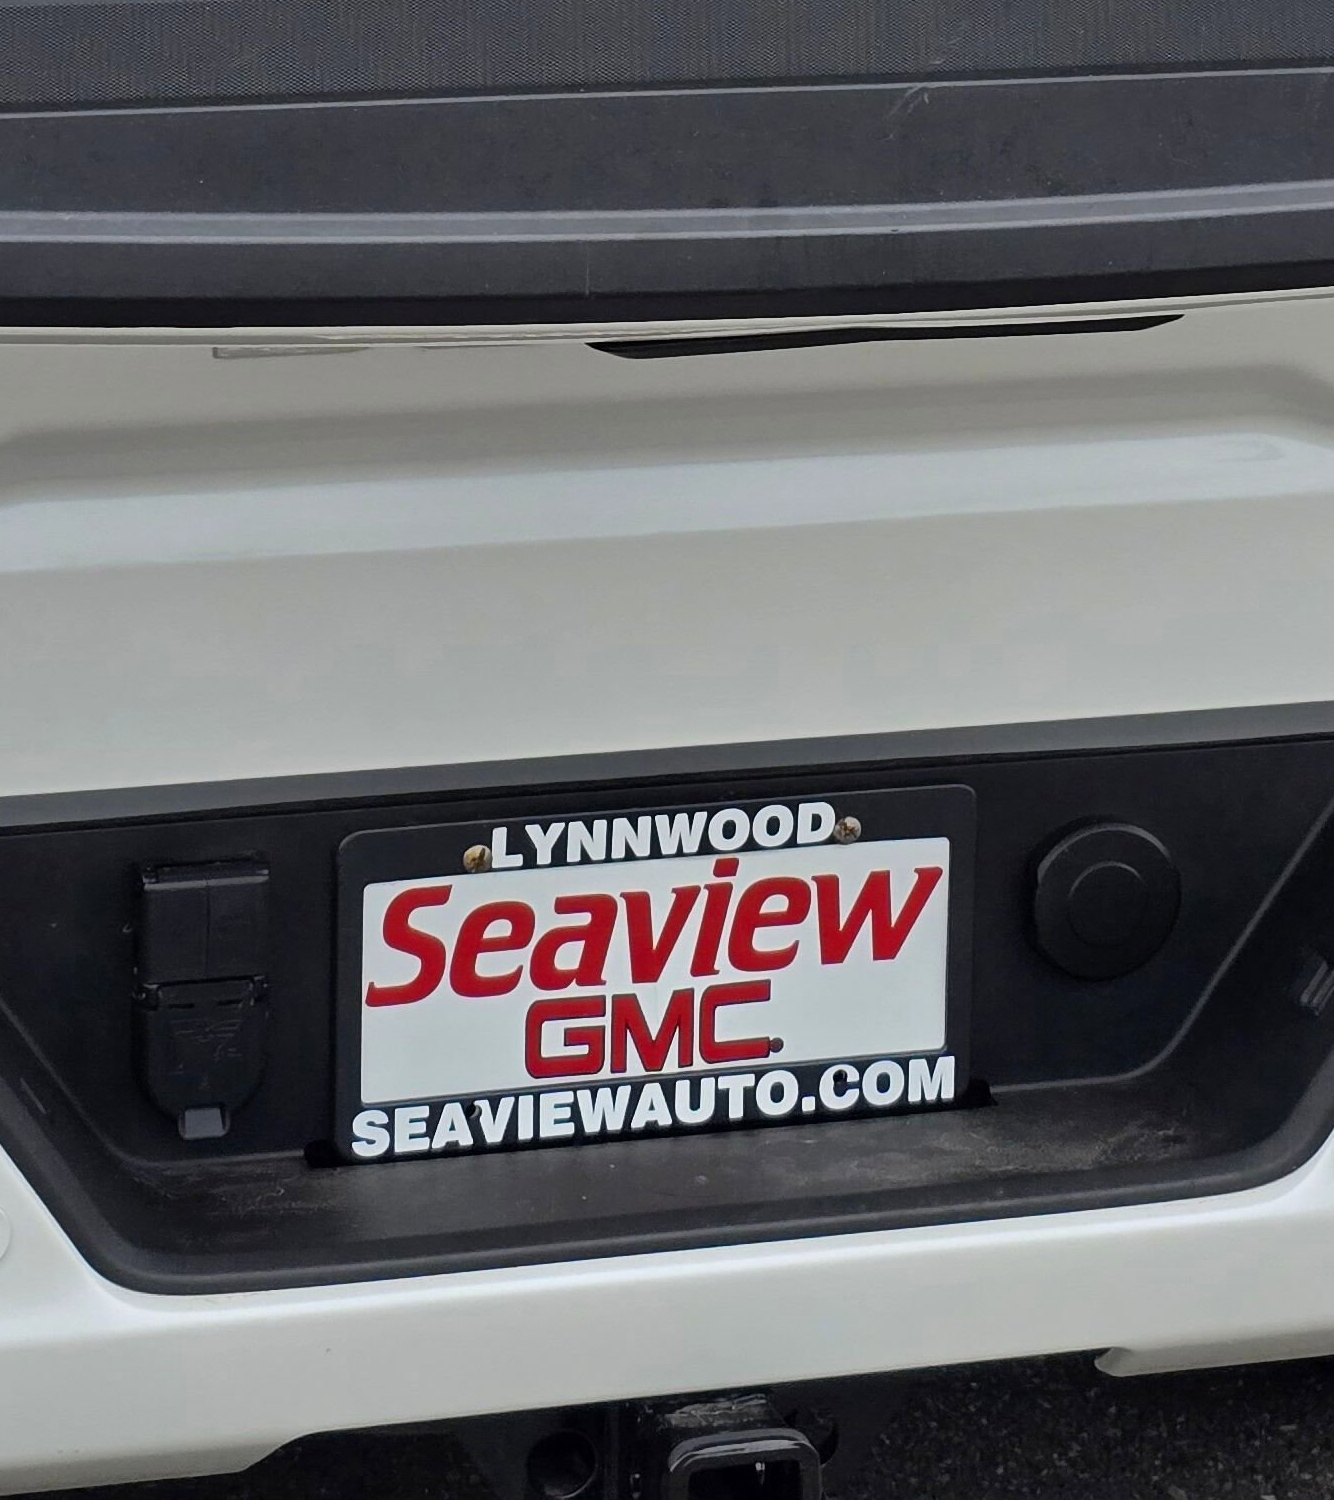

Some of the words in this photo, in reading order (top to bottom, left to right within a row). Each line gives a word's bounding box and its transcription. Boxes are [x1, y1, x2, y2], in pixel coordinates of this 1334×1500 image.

[490, 801, 836, 870] LYNNWOOD
[364, 856, 944, 1007] Seaview
[524, 978, 772, 1079] GMC
[350, 1054, 957, 1159] SEAVIEWAUTO.COM
